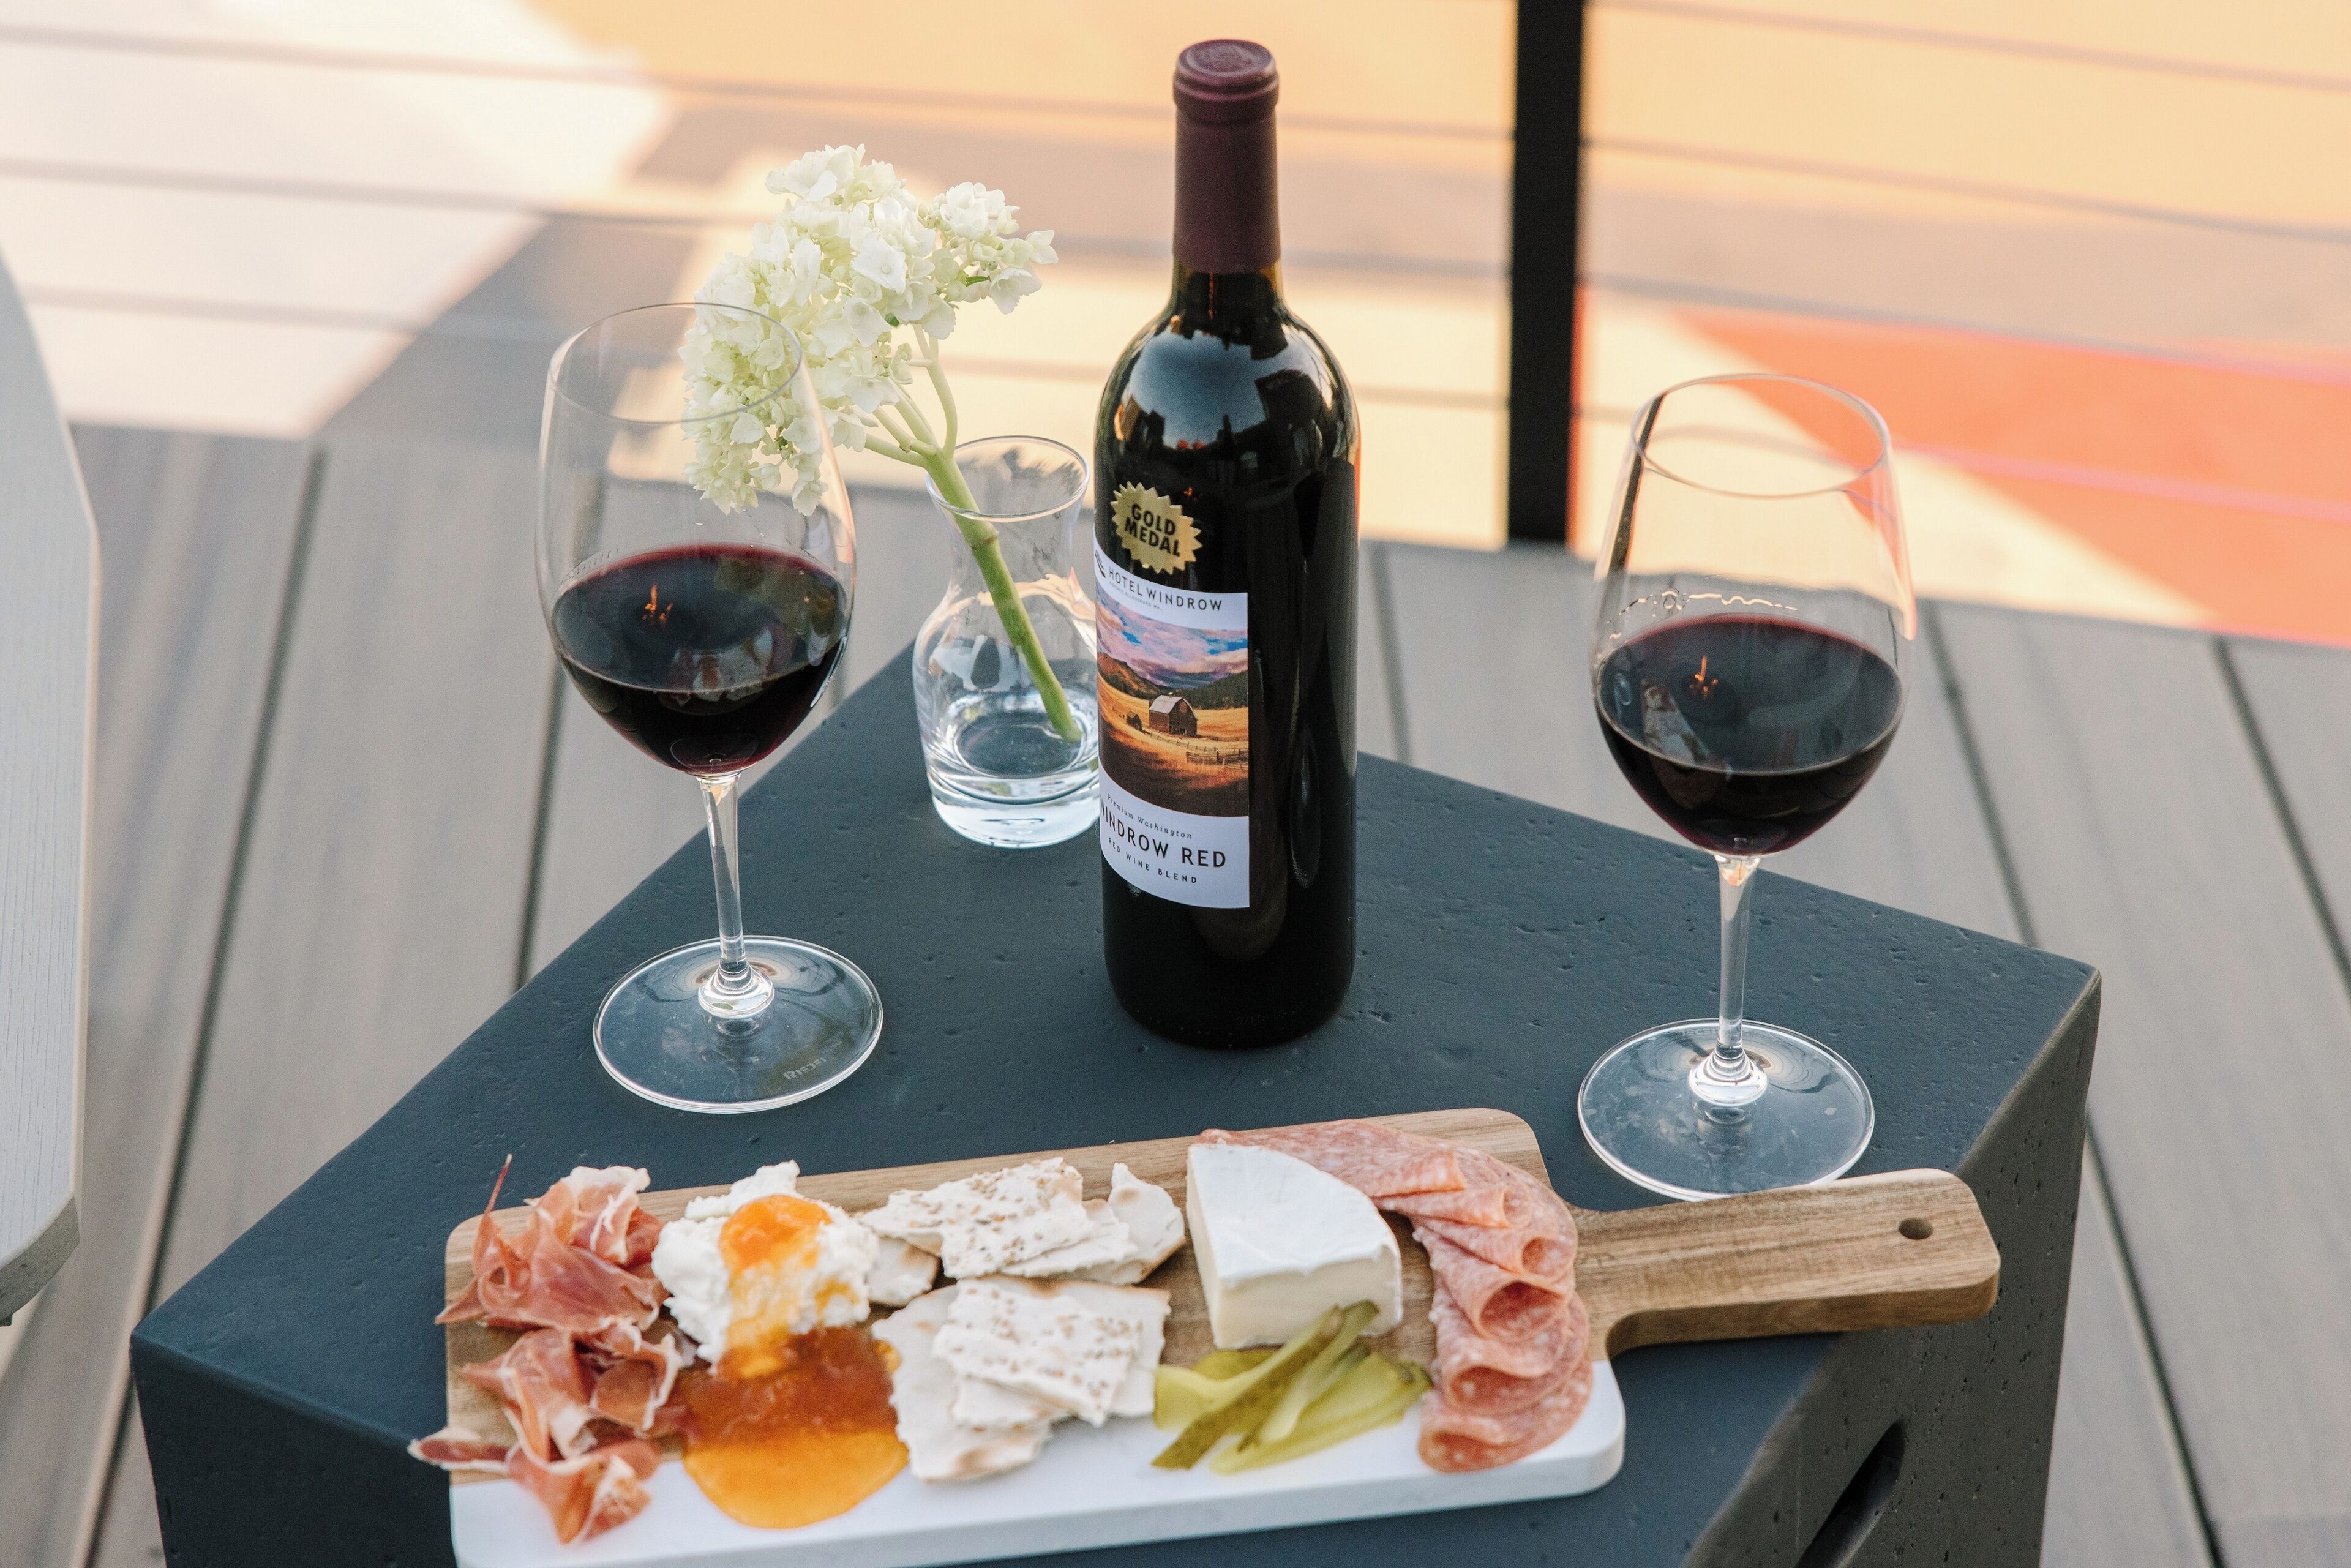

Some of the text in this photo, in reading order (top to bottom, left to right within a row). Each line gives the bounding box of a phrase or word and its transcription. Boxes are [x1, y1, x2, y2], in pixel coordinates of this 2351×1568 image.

[1125, 517, 1180, 557] MEDAL
[1131, 503, 1176, 536] GOLD
[1109, 566, 1222, 611] HOTEL WINDROW
[1108, 793, 1192, 839] Premium Washington
[1109, 837, 1197, 883] RED WINE BLEND
[1182, 847, 1226, 868] RED
